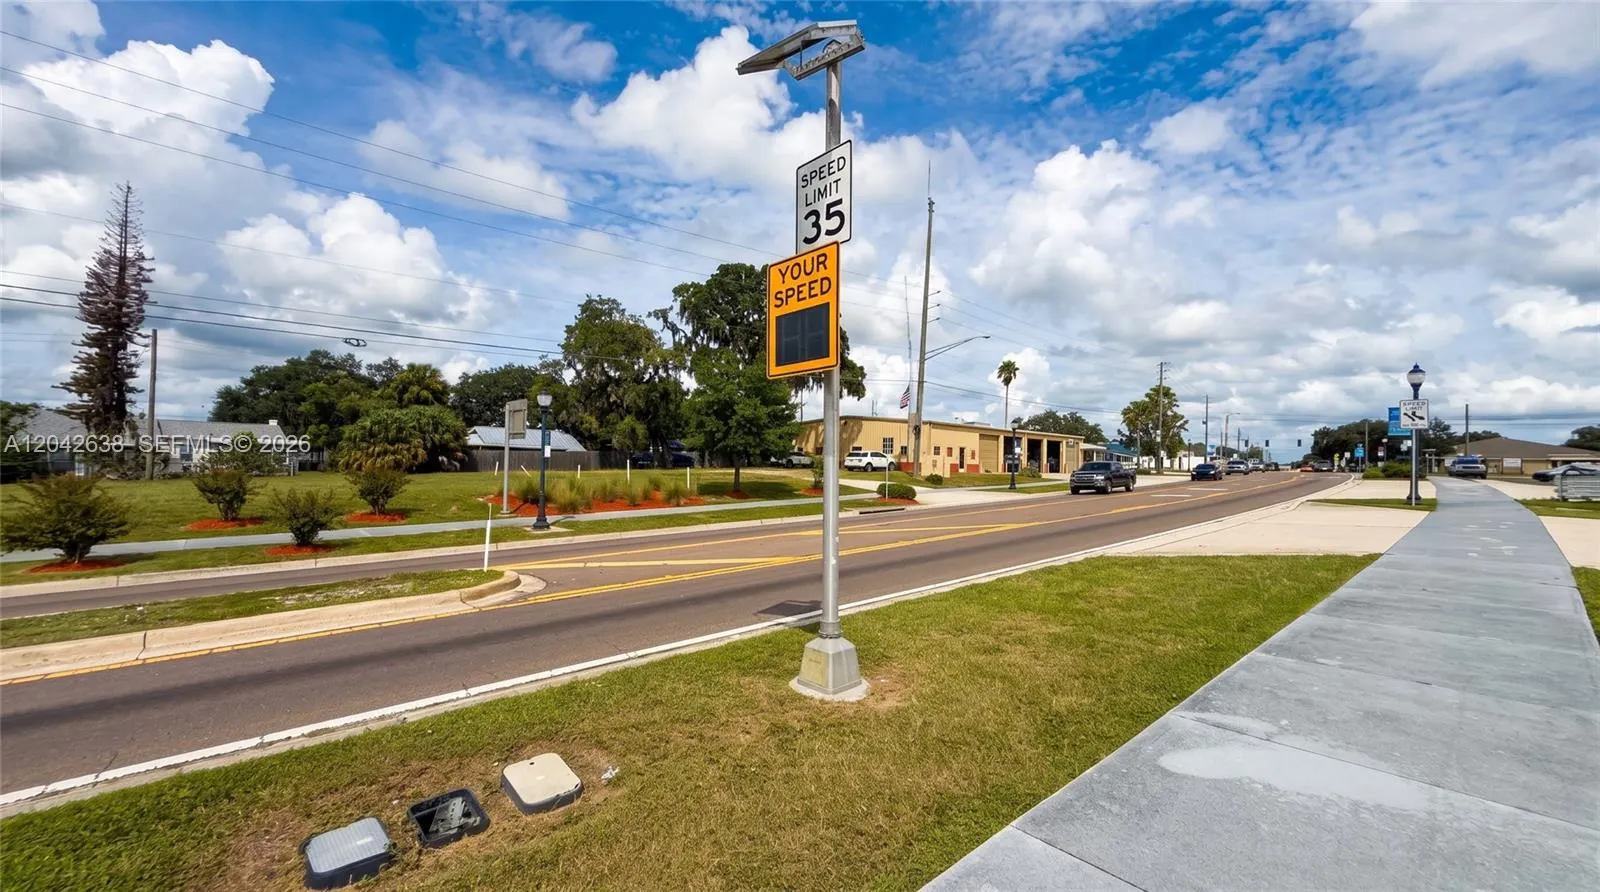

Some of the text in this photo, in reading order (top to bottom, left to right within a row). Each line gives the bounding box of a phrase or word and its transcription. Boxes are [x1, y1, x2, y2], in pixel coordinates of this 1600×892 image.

[801, 156, 846, 188] SPEED
[805, 178, 841, 207] LIMIT
[802, 198, 846, 245] 35
[778, 252, 828, 284] YOUR
[774, 279, 832, 308] SPEED
